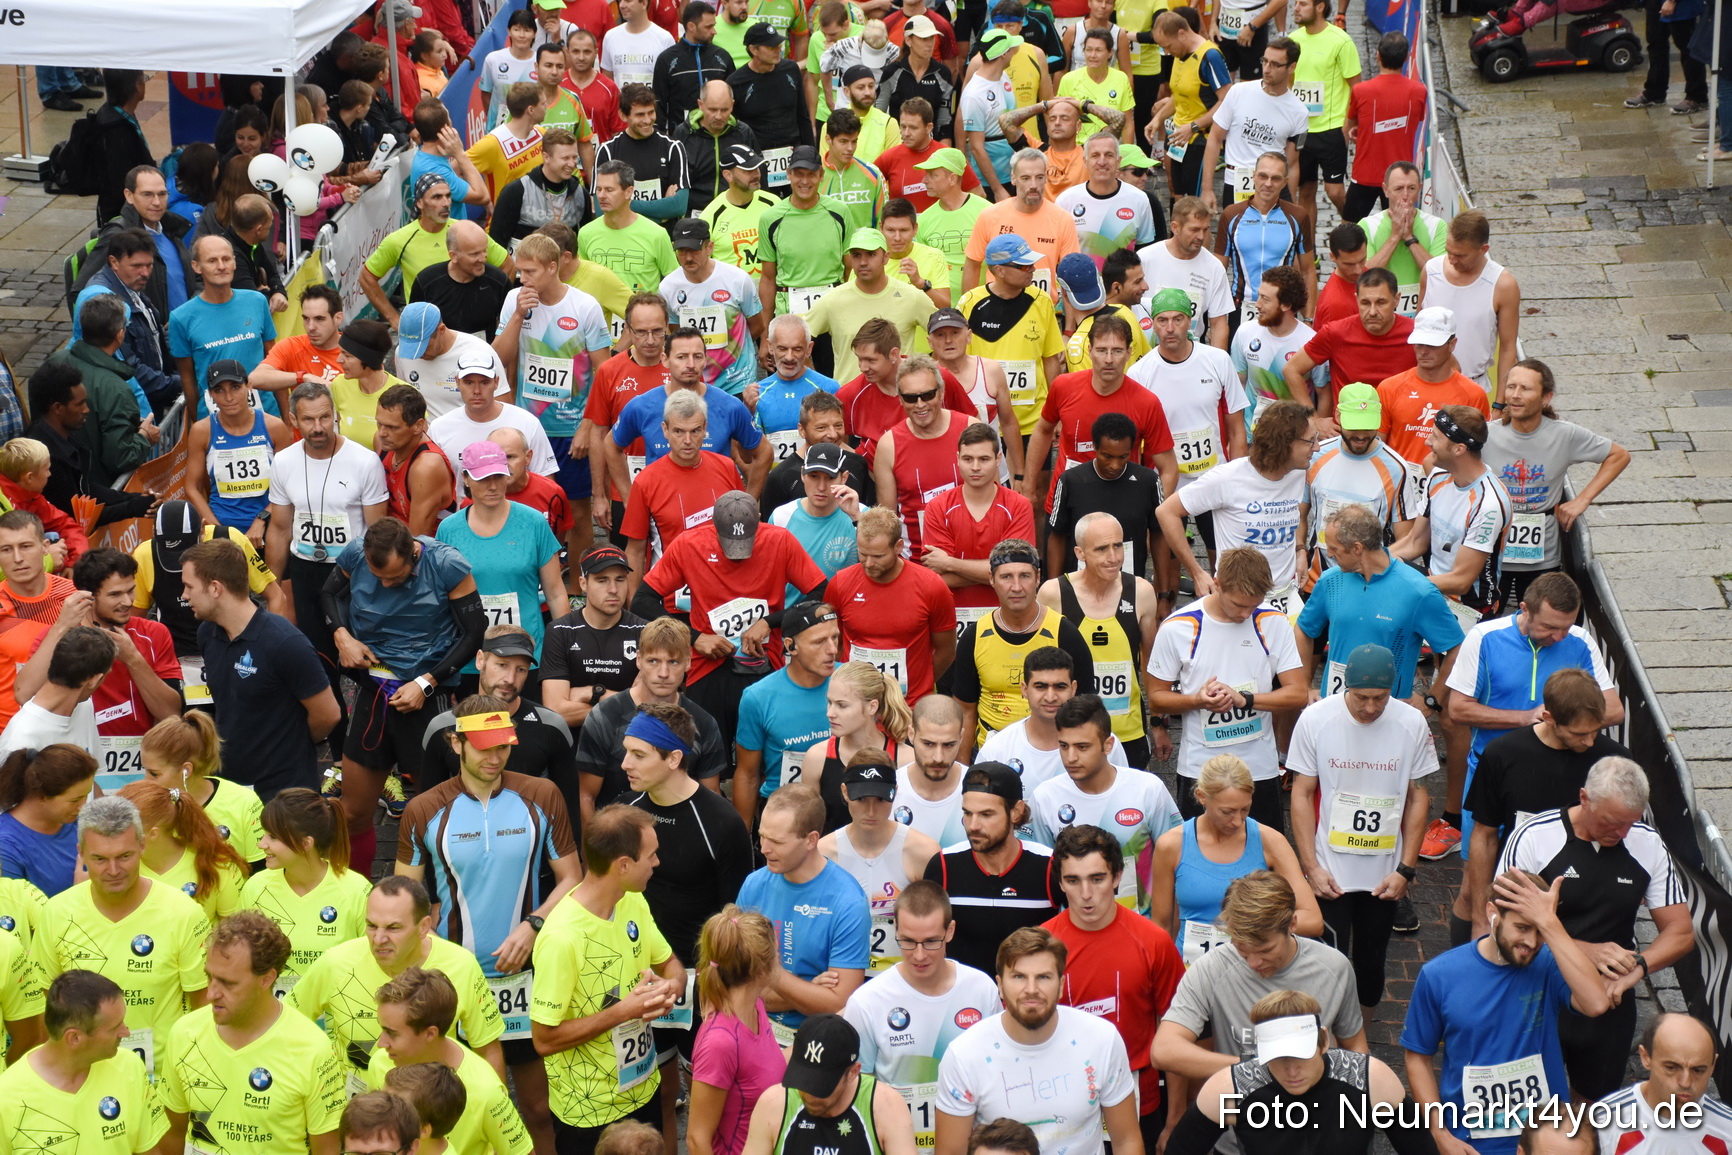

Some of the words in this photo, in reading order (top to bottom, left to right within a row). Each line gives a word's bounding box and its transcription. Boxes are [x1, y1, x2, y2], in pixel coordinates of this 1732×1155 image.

[508, 156, 529, 171] MAX
[981, 321, 1000, 329] Peter
[204, 332, 255, 349] www.hasit.de
[528, 365, 570, 387] 2907
[533, 386, 560, 398] Andreas
[1180, 438, 1213, 461] 313
[226, 459, 262, 481] 133
[1188, 461, 1210, 473] Martin
[226, 485, 263, 495] Alexandra
[301, 523, 347, 545] 2005
[1243, 525, 1299, 546] 2015
[719, 604, 766, 637] 2372
[582, 658, 597, 666] LLC
[599, 658, 622, 667] Marathon
[585, 666, 620, 677] Regensburg
[105, 708, 123, 718] DEHN
[783, 728, 832, 745] www.hasi
[1215, 722, 1254, 739] Christoph
[1328, 757, 1400, 772] Kaiserwinkl
[1119, 812, 1141, 823] Hervis
[1353, 809, 1380, 832] 63
[1347, 836, 1380, 848] Roland
[317, 925, 337, 935] Partl
[784, 921, 793, 950] SWIM
[127, 959, 153, 969] Partl
[125, 997, 155, 1006] YEARS
[958, 1012, 980, 1025] Hervis
[889, 1034, 915, 1042] PARTL
[890, 1039, 916, 1048] Neumarkt
[1495, 1060, 1536, 1077] BOCK
[244, 1093, 271, 1106] Partl
[101, 1121, 126, 1137] Partl
[217, 1121, 235, 1131] THE
[235, 1123, 259, 1135] NEXT
[226, 1131, 241, 1141] 100
[242, 1132, 273, 1143] YEARS
